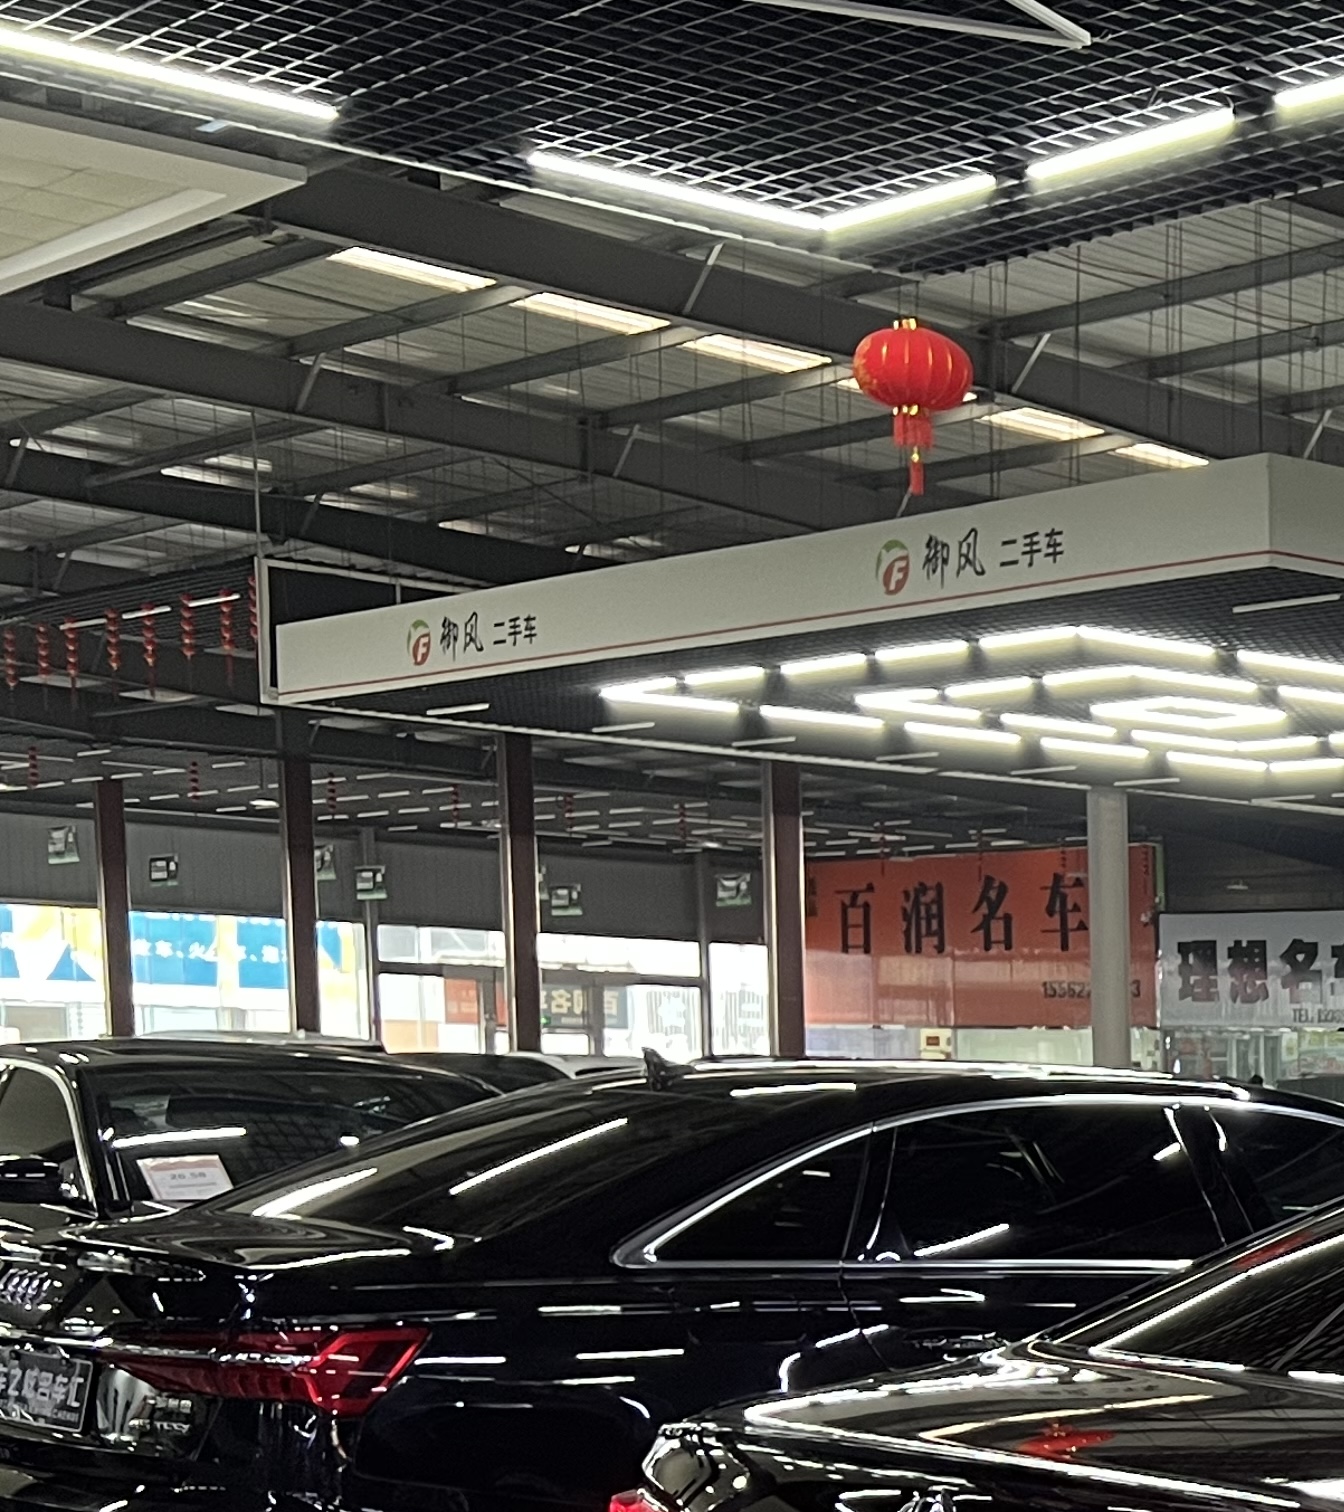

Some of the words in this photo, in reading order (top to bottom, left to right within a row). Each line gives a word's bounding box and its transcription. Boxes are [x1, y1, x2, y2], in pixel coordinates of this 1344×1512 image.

[1000, 528, 1064, 568] 二手车
[493, 614, 537, 647] 二手车
[835, 873, 1089, 955] 百润名车
